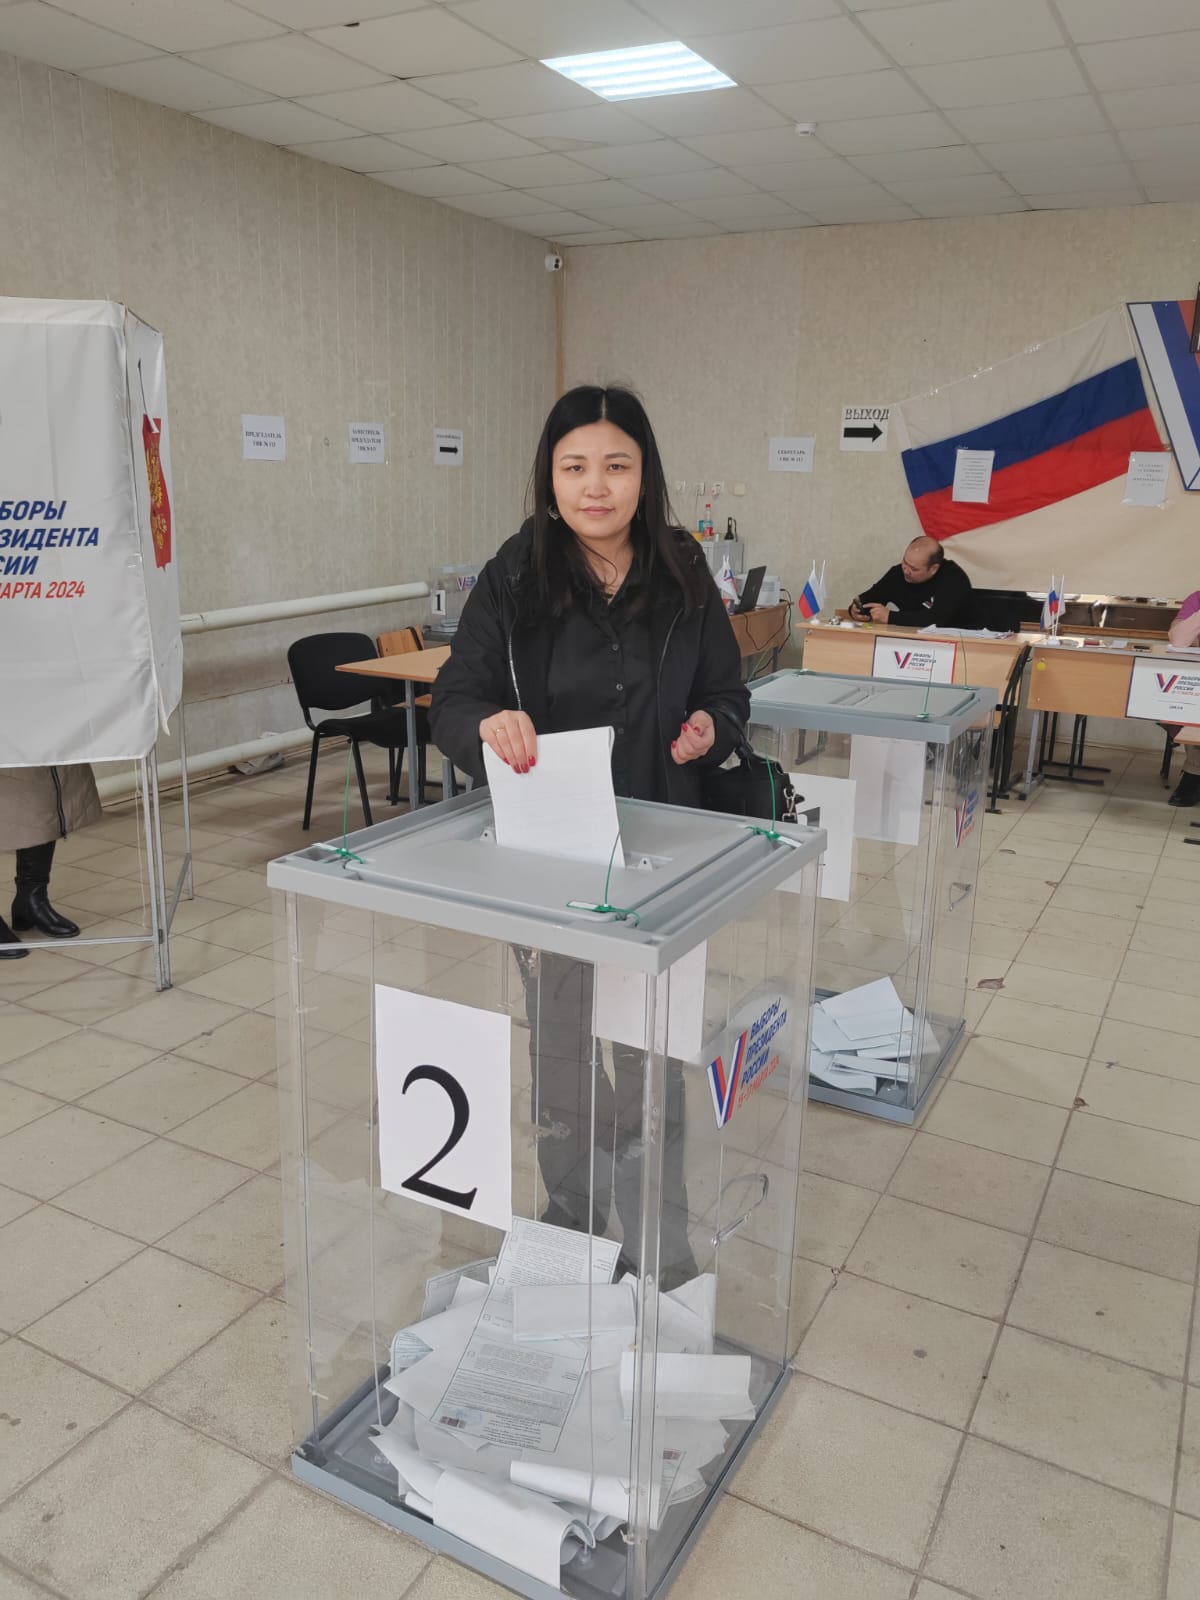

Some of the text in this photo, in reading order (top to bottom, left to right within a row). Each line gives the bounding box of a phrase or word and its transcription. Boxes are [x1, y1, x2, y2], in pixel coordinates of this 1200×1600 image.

[845, 408, 889, 422] ВЫХОД
[45, 580, 85, 598] 2024
[435, 593, 442, 612] 1
[745, 1009, 788, 1065] ПРЕЗИДЕНТА
[750, 997, 781, 1041] ВЫБОРЫ
[741, 1046, 770, 1089] РОССИИ
[401, 1064, 478, 1210] 2
